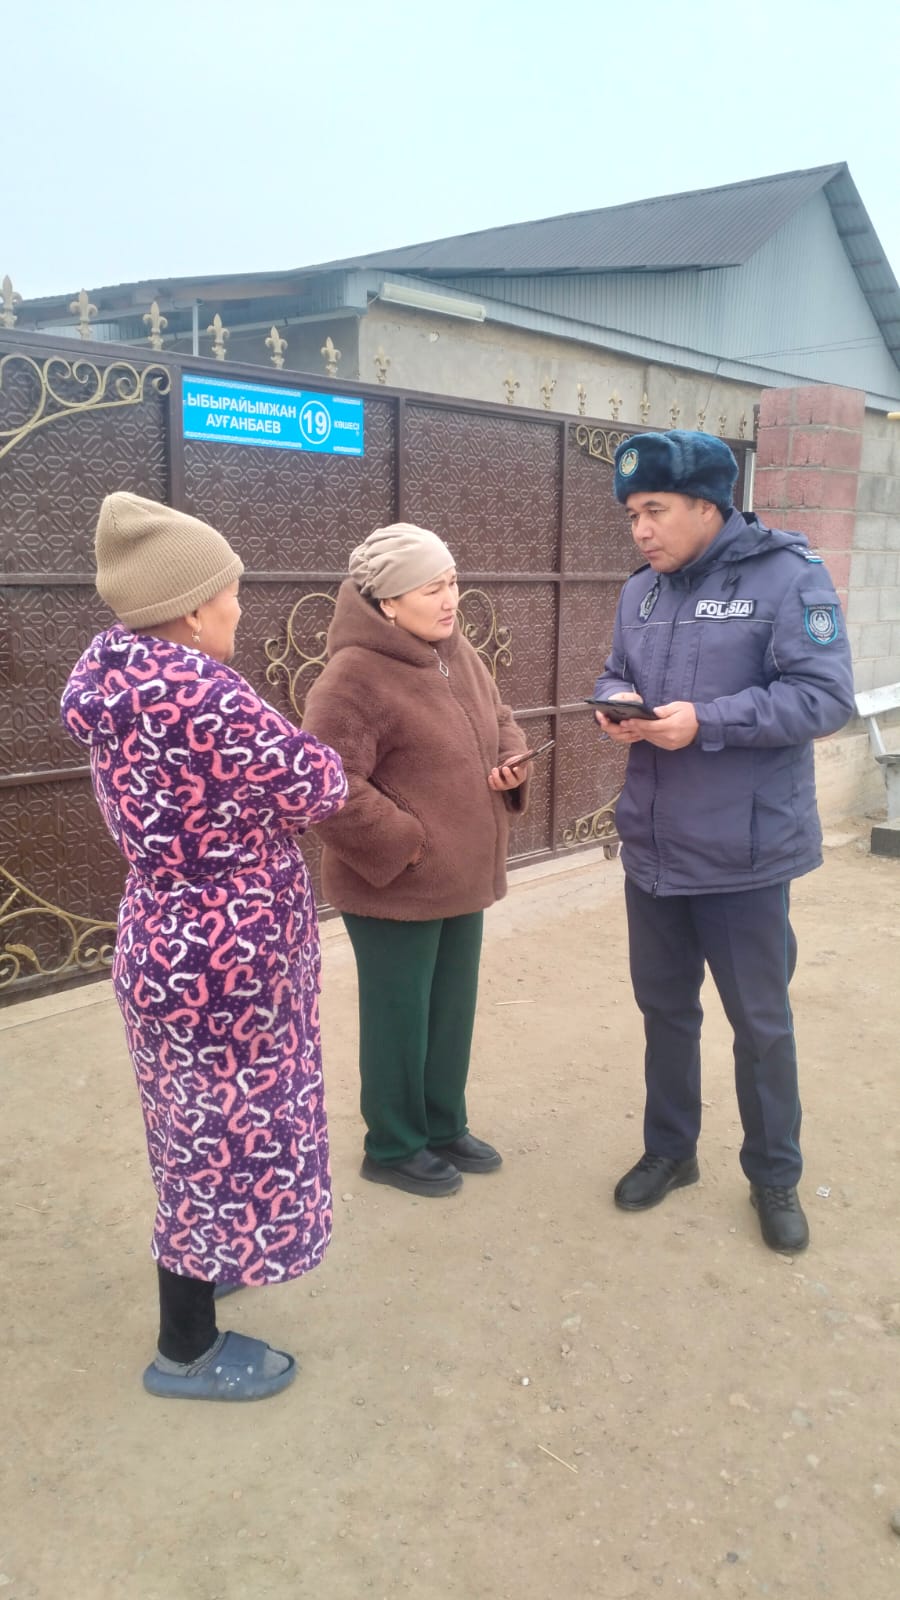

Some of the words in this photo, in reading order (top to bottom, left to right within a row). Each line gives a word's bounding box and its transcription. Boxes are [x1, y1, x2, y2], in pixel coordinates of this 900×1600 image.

[187, 392, 296, 418] ЫБЫРАЙЫМЖАН
[206, 413, 281, 434] АУҒАНБАЕВ
[303, 410, 327, 435] 19
